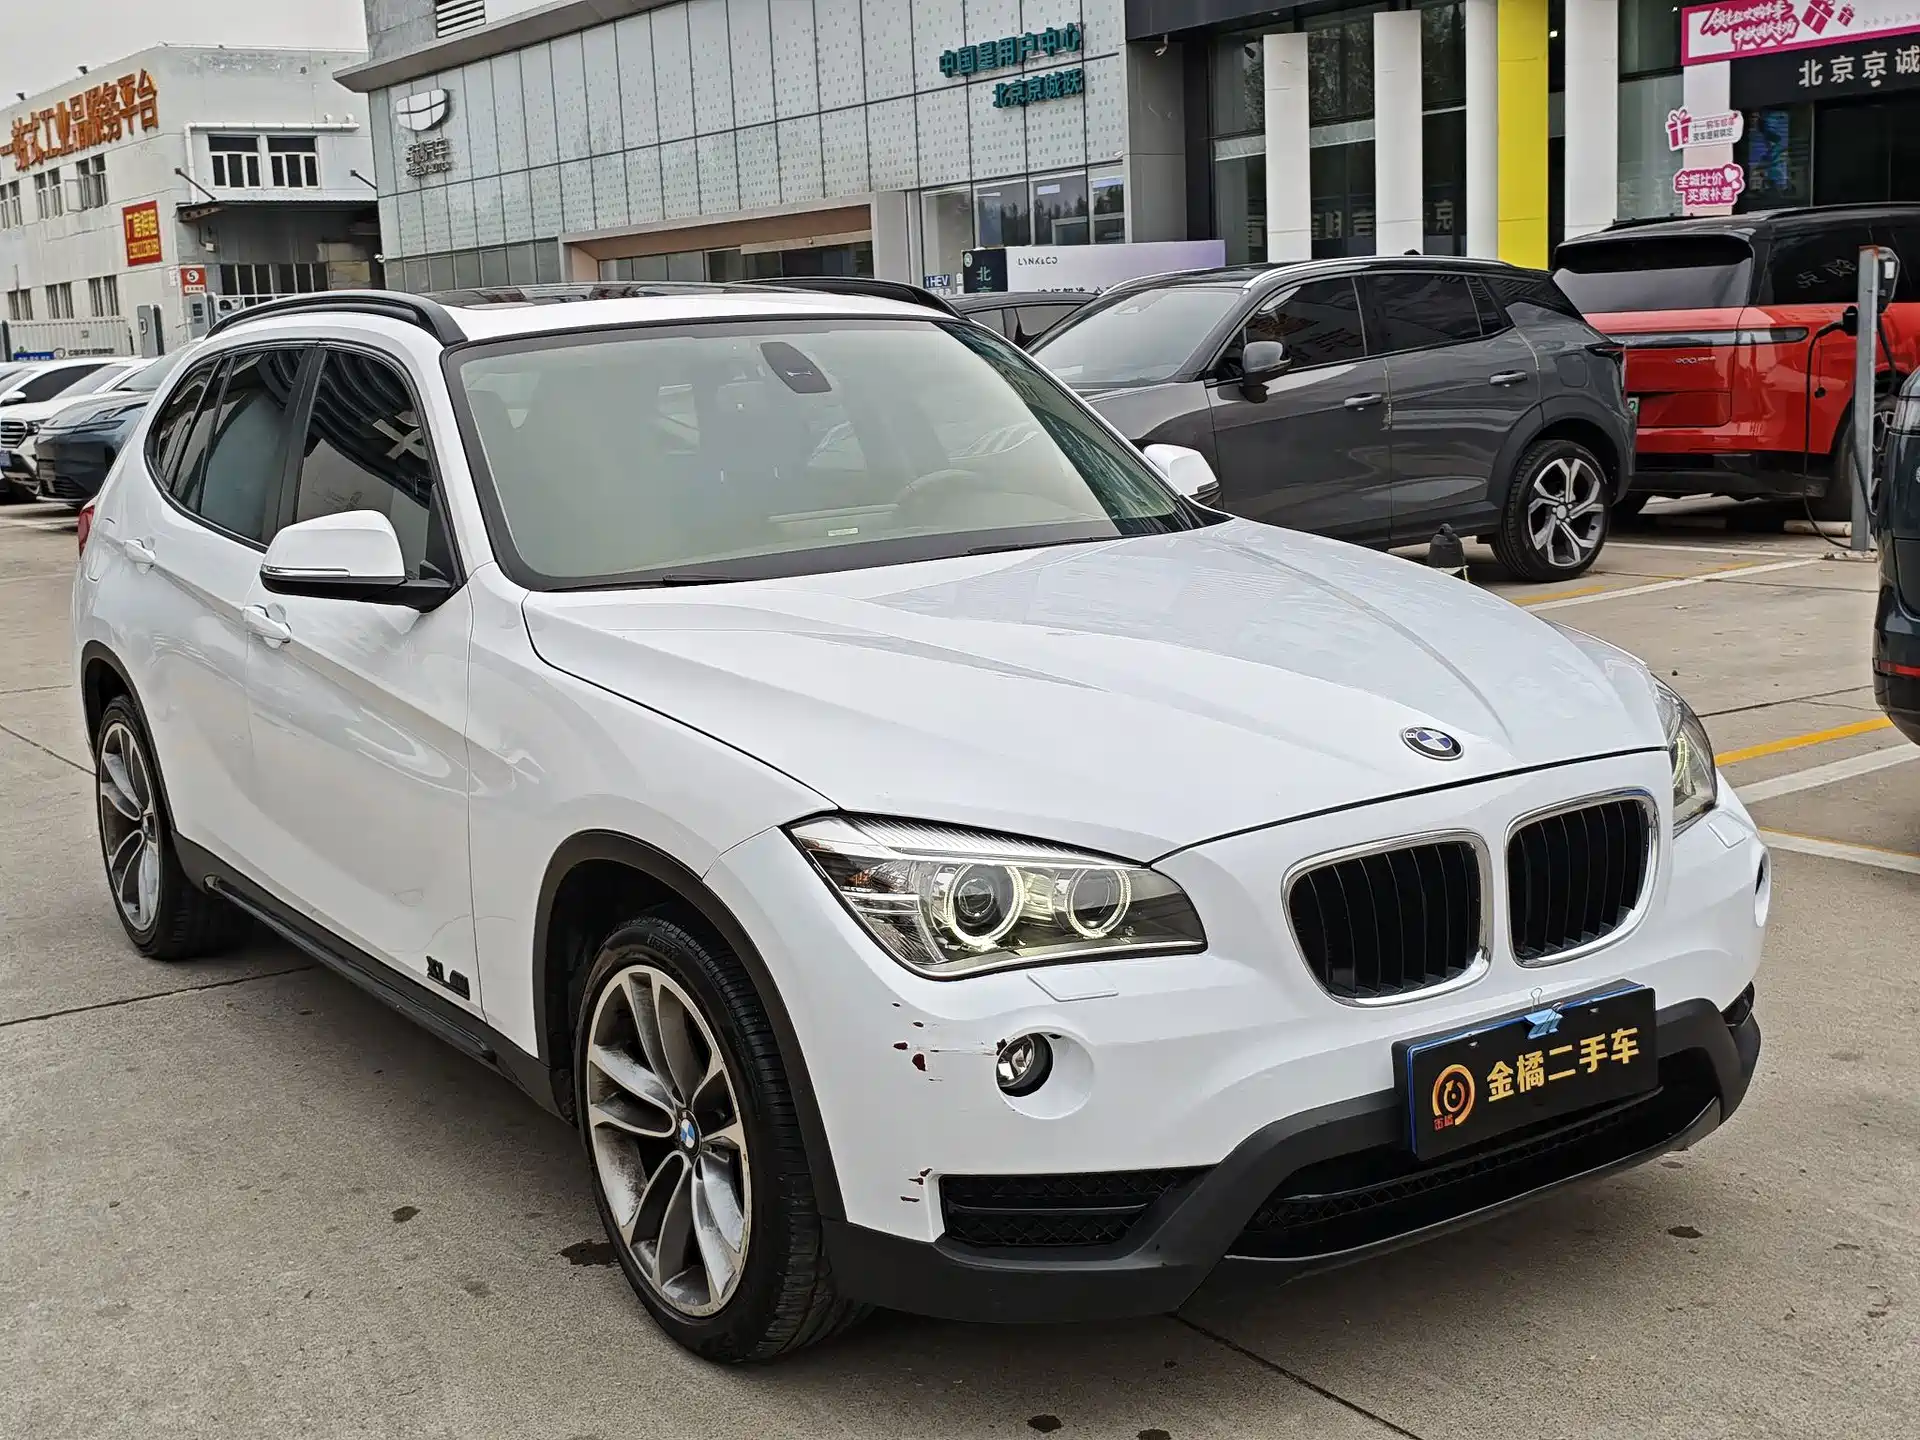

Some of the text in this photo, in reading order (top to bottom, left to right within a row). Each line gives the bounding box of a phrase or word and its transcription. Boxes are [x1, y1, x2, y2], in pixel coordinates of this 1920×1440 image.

[939, 23, 1081, 78] 中国星用户中心
[188, 271, 197, 280] 5
[1486, 1027, 1640, 1102] 金橘二手车
